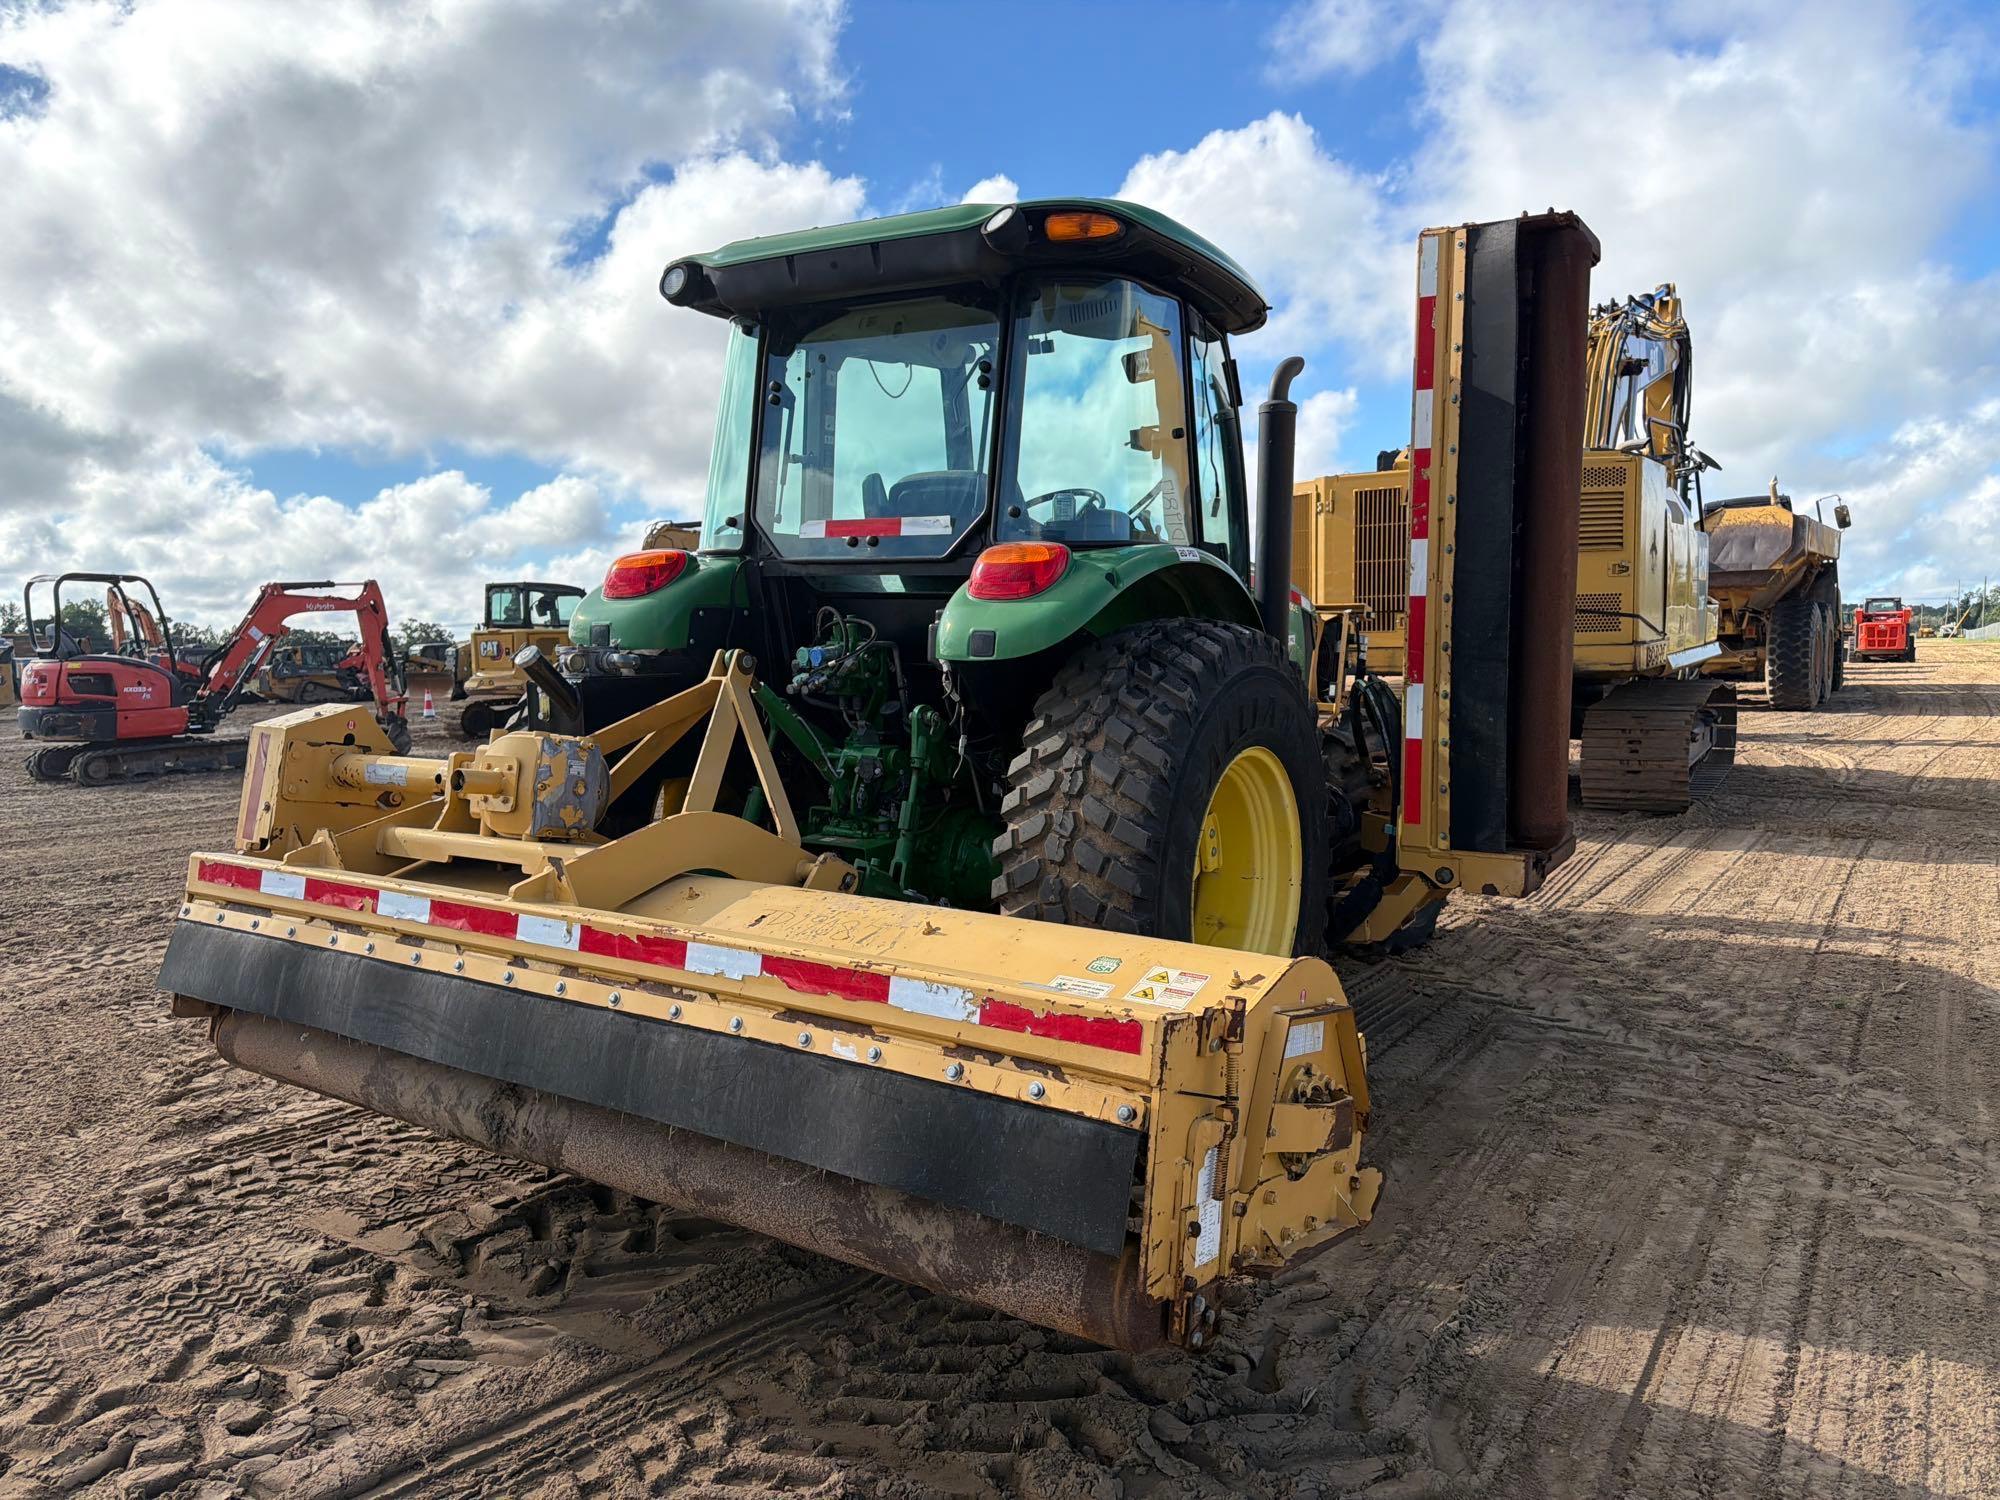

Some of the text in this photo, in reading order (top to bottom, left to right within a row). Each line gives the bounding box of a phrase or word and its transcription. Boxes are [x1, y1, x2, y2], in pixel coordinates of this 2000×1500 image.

[305, 602, 336, 611] Kubota
[480, 641, 499, 657] CAT
[1090, 964, 1112, 972] USA
